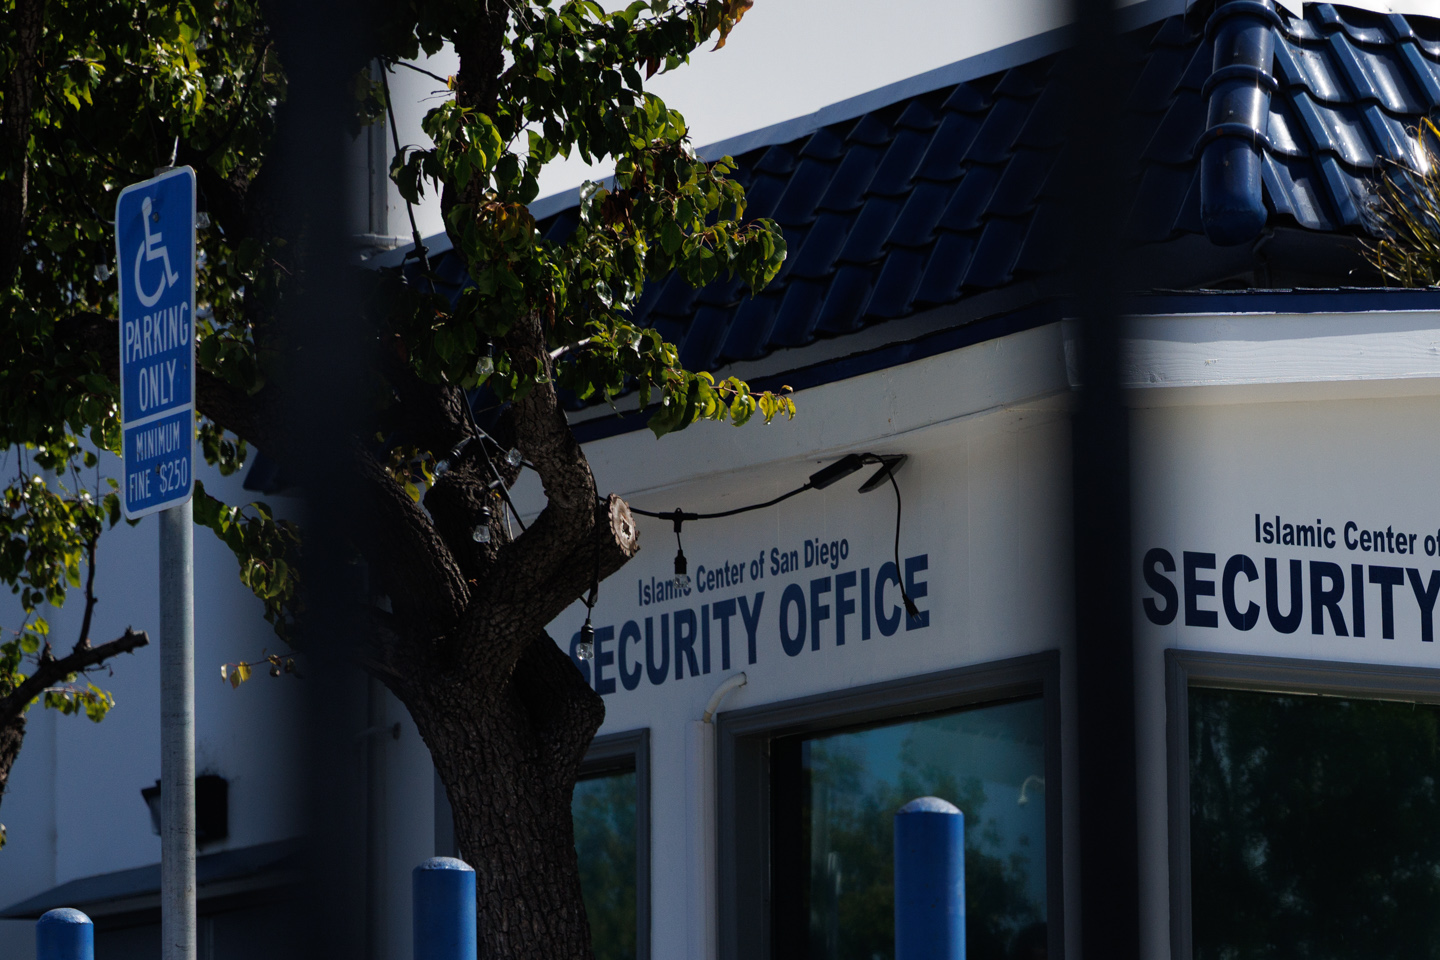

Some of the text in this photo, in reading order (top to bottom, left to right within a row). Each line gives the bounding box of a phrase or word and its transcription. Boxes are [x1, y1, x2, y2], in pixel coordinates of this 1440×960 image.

[125, 301, 189, 364] PARKING
[138, 358, 177, 412] ONLY
[136, 420, 180, 463] MINIMUM
[129, 456, 188, 503] FINE $250
[1254, 513, 1336, 549] Islamic
[1343, 520, 1417, 556] Center
[696, 559, 746, 594] Center
[749, 550, 766, 581] of
[769, 547, 799, 576] San
[804, 537, 849, 570] Diego
[569, 553, 930, 696] SECURITY OFFICE
